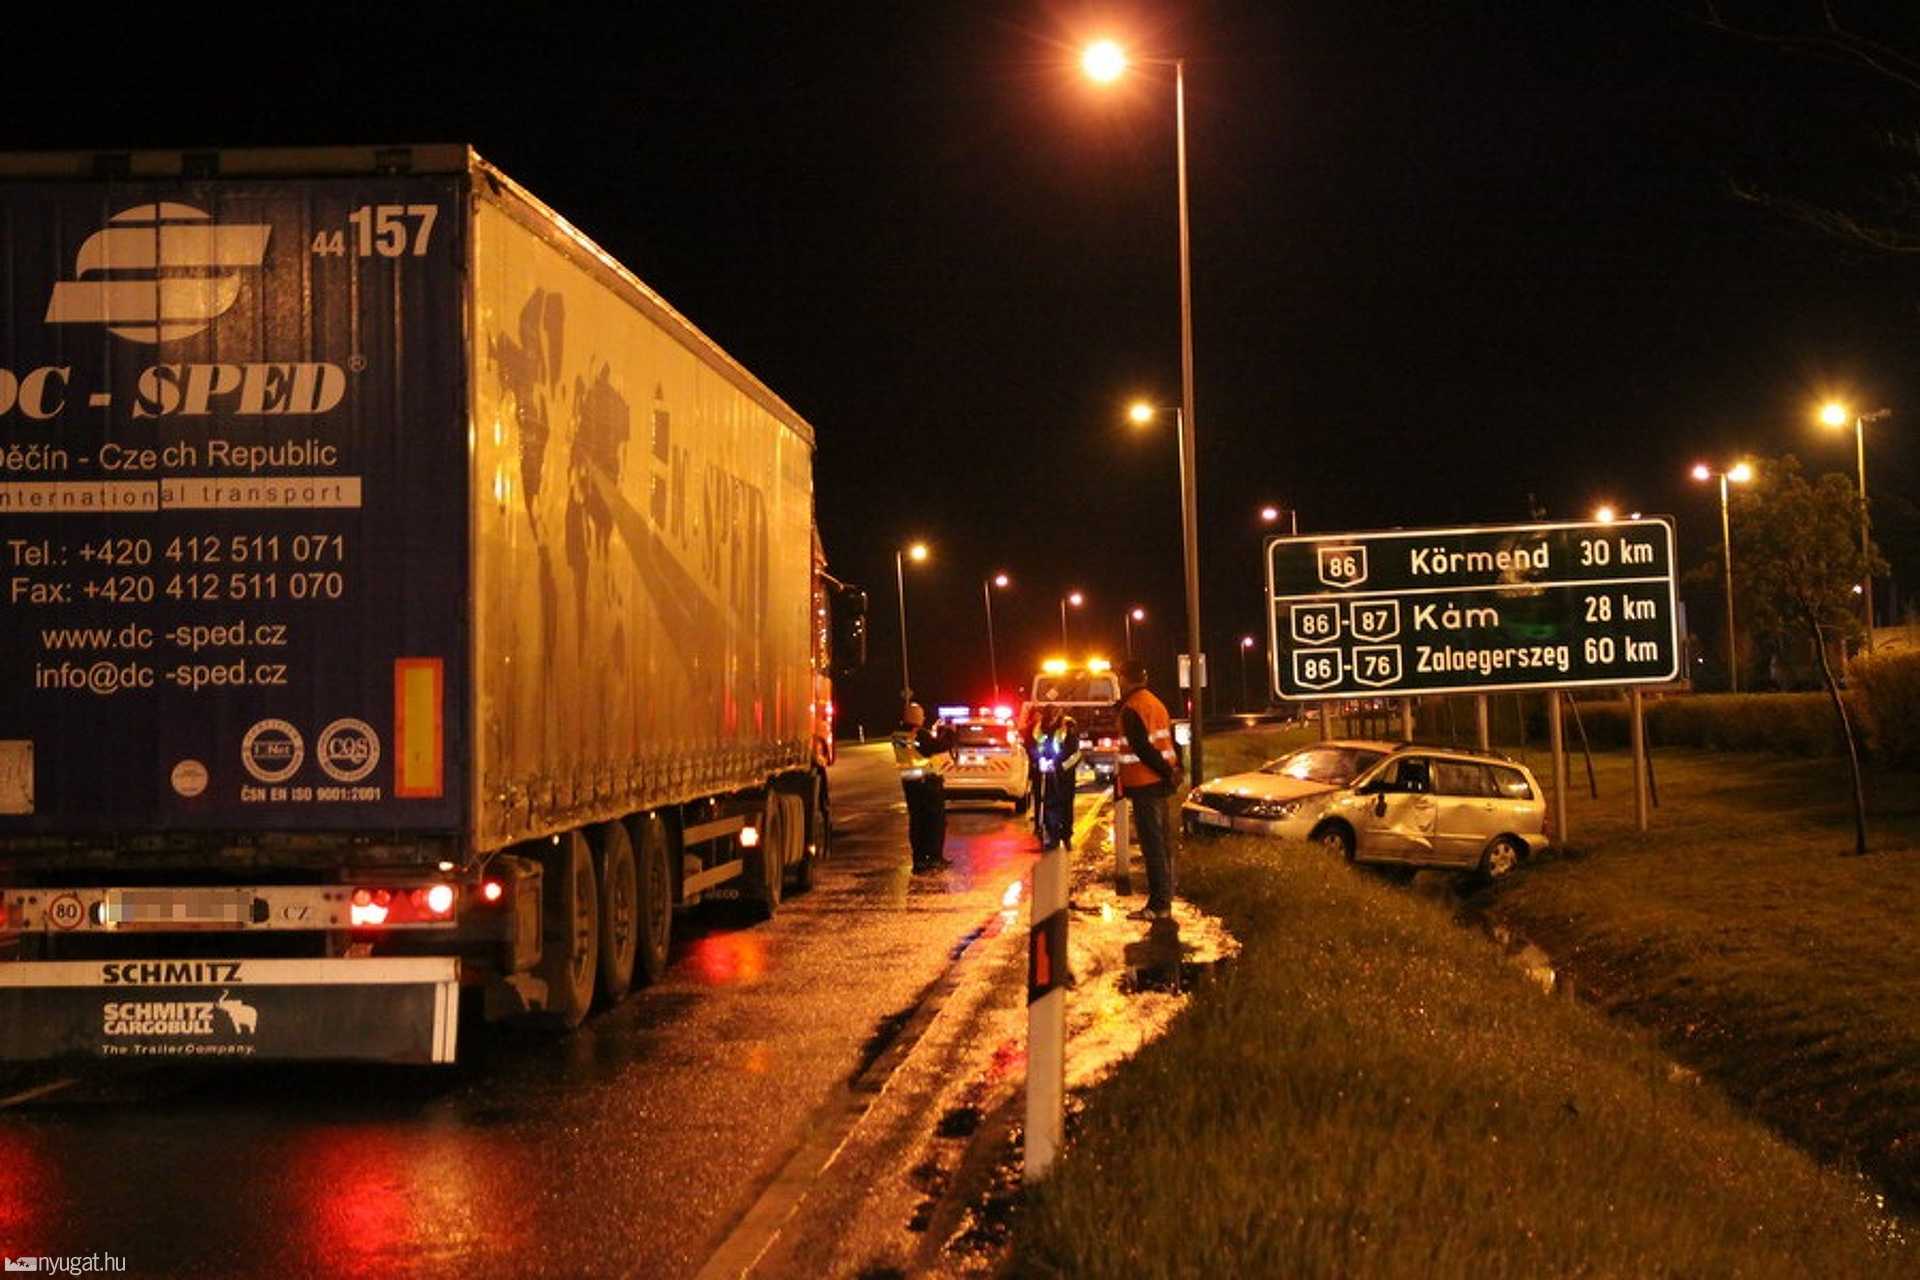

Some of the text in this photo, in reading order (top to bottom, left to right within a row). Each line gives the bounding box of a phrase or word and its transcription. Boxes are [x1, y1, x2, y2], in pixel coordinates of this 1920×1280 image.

[0, 444, 68, 471] ěčín
[99, 441, 196, 470] Czech
[208, 439, 337, 473] Republic
[202, 482, 343, 504] transport
[8, 535, 344, 566] Tel.: +420 412 511 071
[1329, 538, 1654, 578] 86 Körmend 30 km
[11, 573, 343, 602] Fax: +420 412 511 070
[1302, 615, 1329, 634] 86
[1361, 611, 1387, 631] 87
[1585, 597, 1612, 622] 28
[1623, 594, 1657, 620] km
[1304, 660, 1332, 679] 86
[1364, 656, 1390, 676] 76
[1416, 644, 1569, 674] Zalaegerszeg
[1584, 640, 1614, 664] 60
[1626, 636, 1658, 661] km
[56, 903, 78, 919] 80
[102, 962, 243, 984] SCHMITZ
[103, 1002, 214, 1021] SCHMITZ
[103, 1021, 214, 1035] CARGOBULL
[102, 1045, 128, 1054] The
